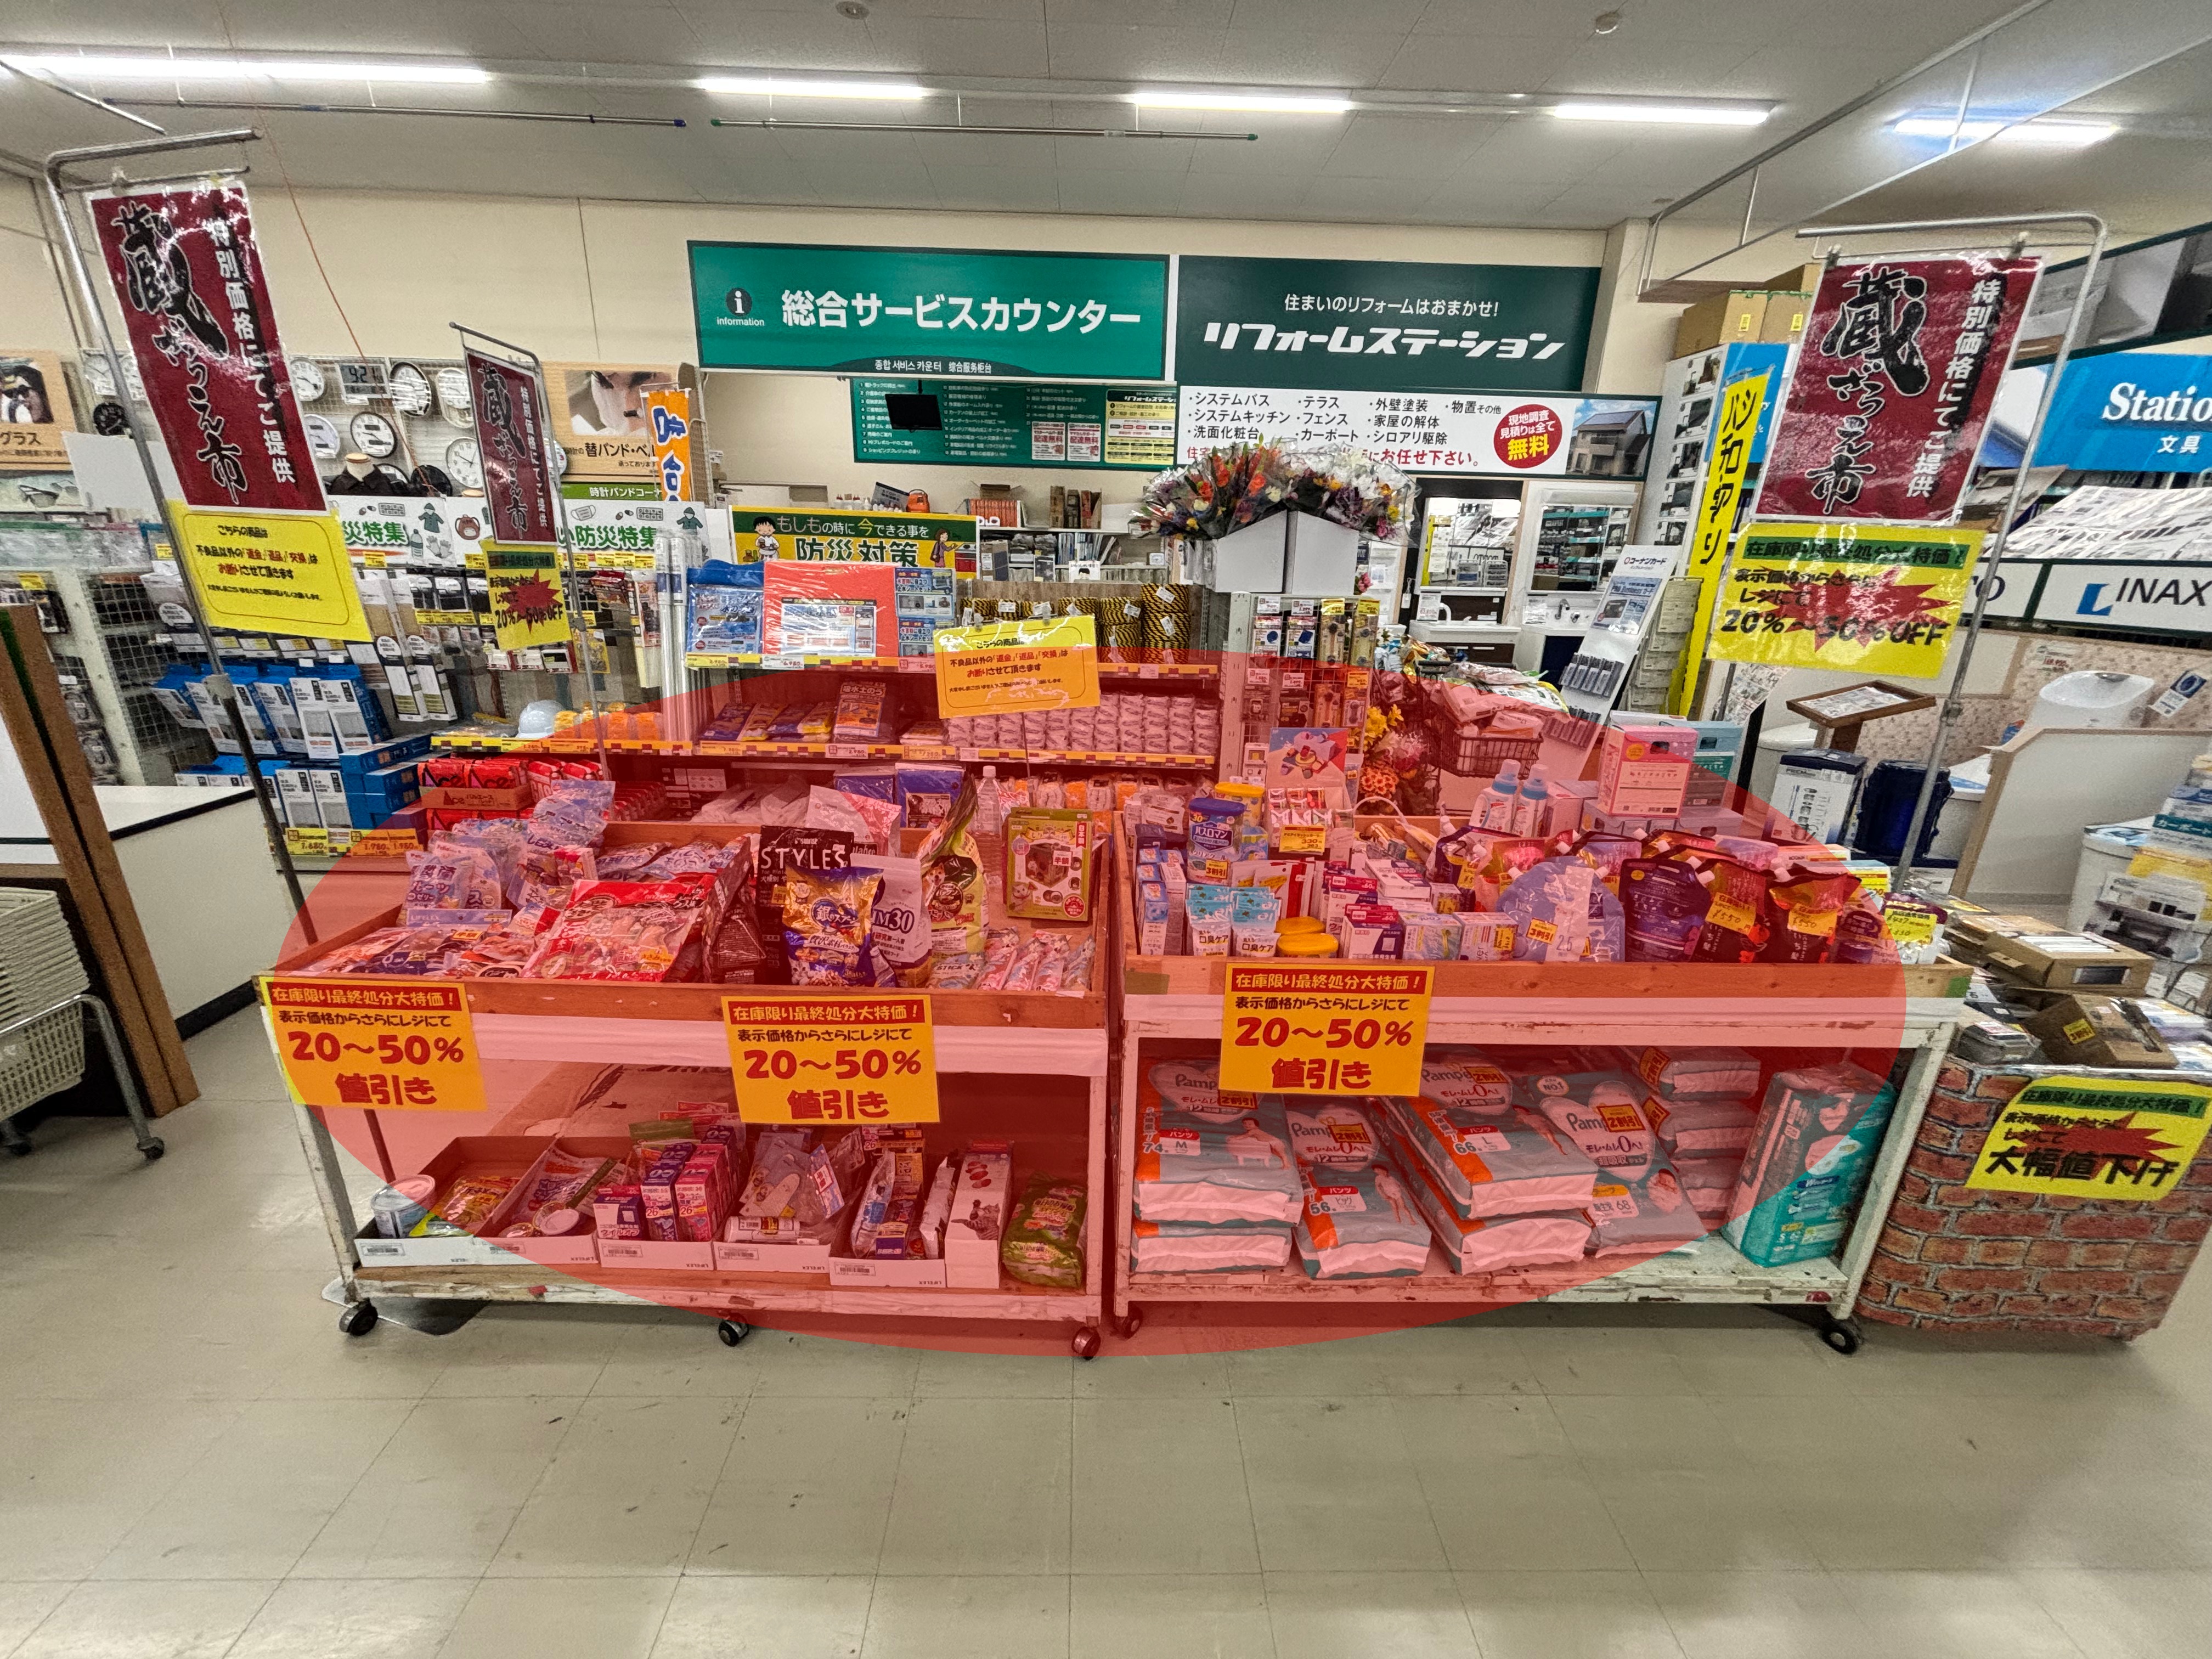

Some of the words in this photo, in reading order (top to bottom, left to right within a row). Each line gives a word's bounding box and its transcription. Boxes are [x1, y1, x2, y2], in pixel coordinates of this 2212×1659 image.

[782, 289, 1141, 334] 総合サービスカウンター
[1284, 294, 1499, 318] 住まいのリフォームはおまかせ!
[716, 316, 765, 326] information
[1204, 321, 1565, 360] リフォームステーション
[875, 359, 891, 371] 종합
[893, 359, 916, 373] 서비스
[918, 360, 942, 373] 카운터
[949, 360, 992, 374] 综合服务柜台
[1907, 277, 2001, 498] 特別価格にてご提供
[1508, 410, 1550, 426] 現地調査
[1500, 420, 1556, 439] 見積りは全て
[1508, 434, 1549, 461] 無料
[2158, 436, 2201, 454] 文具
[777, 515, 855, 535] もしもの時に
[857, 518, 929, 538] 今できる事を
[795, 537, 919, 567] 防災対策
[2115, 577, 2212, 606] INAX
[760, 848, 847, 870] STYLES
[1199, 935, 1229, 944] 口臭ケア
[1242, 943, 1274, 952] 口臭ケア
[1235, 996, 1410, 1011] 表示価格からさらにレジにて
[279, 1010, 452, 1028] 表示価格からさらにレジにて
[737, 1029, 912, 1042] 表示価格からさらにレジにて
[1175, 1074, 1217, 1091] Pamp
[1271, 1058, 1372, 1090] 値引き
[1421, 1069, 1472, 1082] Pampe
[335, 1073, 438, 1105] 値引き
[787, 1090, 890, 1120] 値引き
[1291, 1122, 1331, 1138] Pamp
[1567, 1113, 1609, 1132] Pamp
